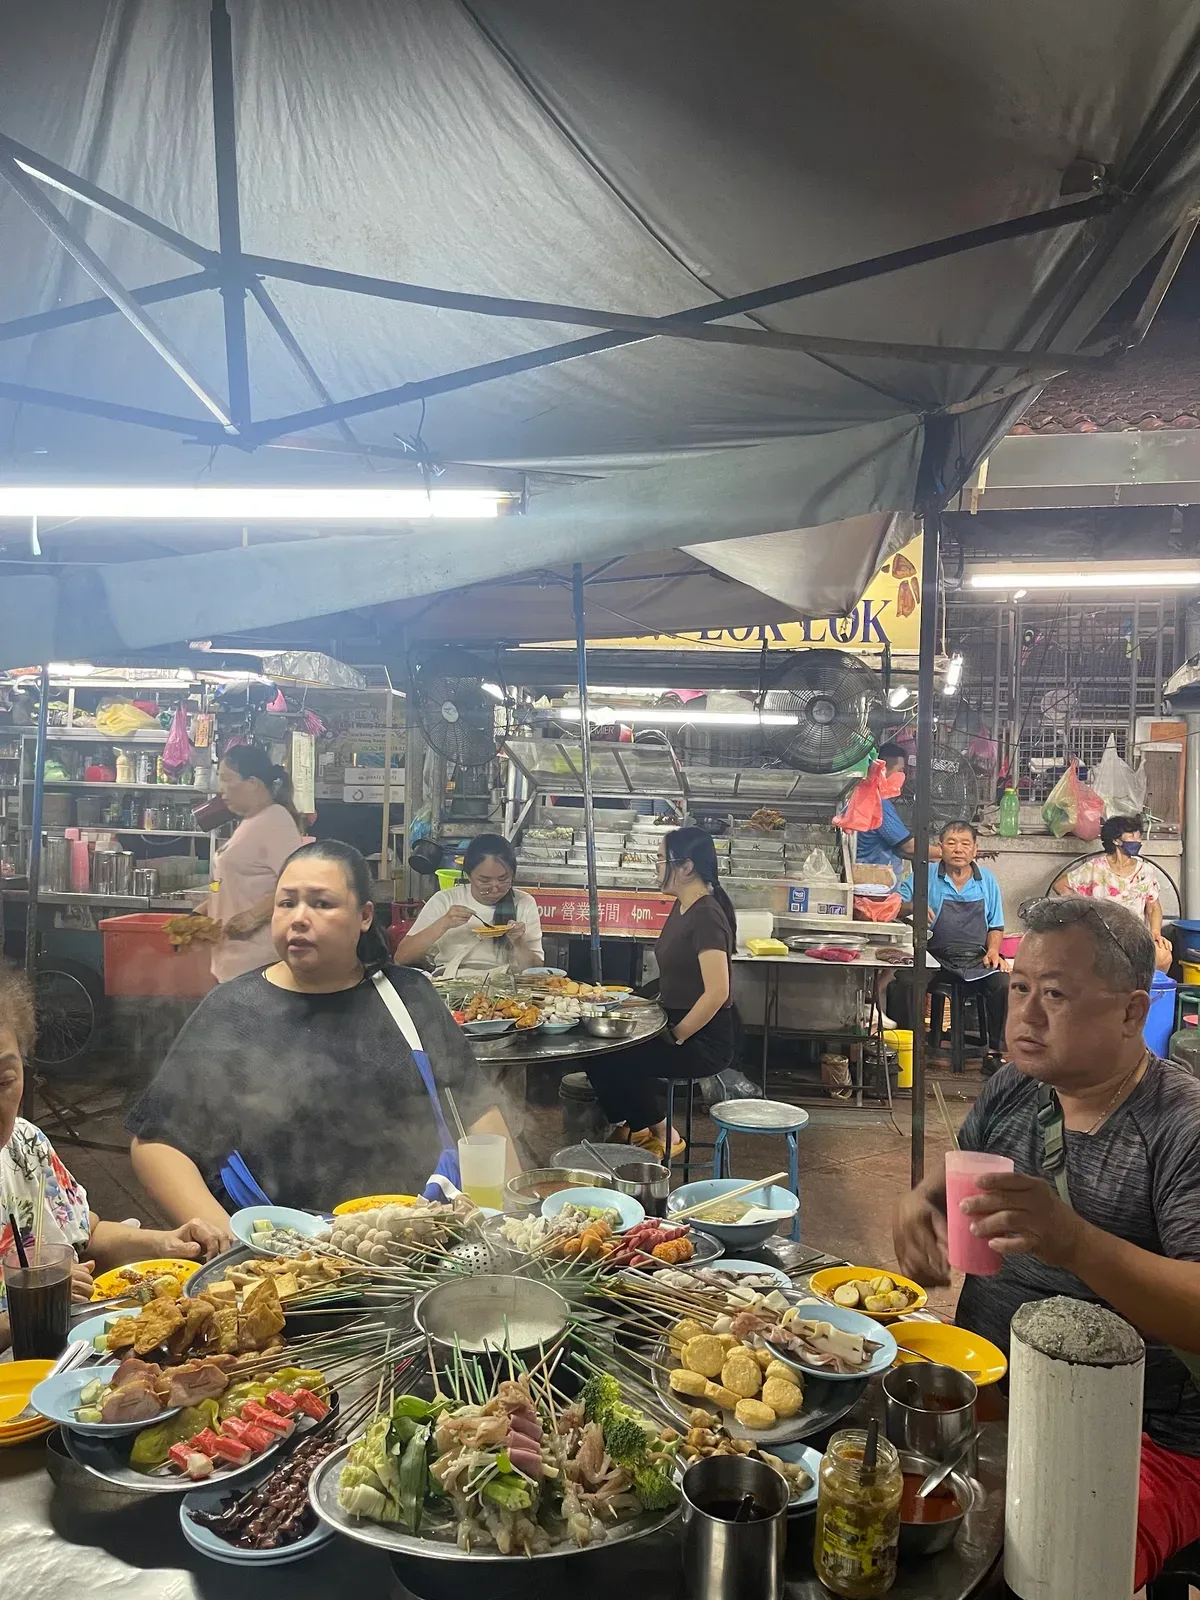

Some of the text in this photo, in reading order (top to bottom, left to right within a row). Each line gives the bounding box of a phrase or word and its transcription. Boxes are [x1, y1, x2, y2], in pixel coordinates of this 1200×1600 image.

[802, 600, 892, 643] LOK
[537, 905, 556, 918] our
[631, 905, 653, 923] 4pm.
